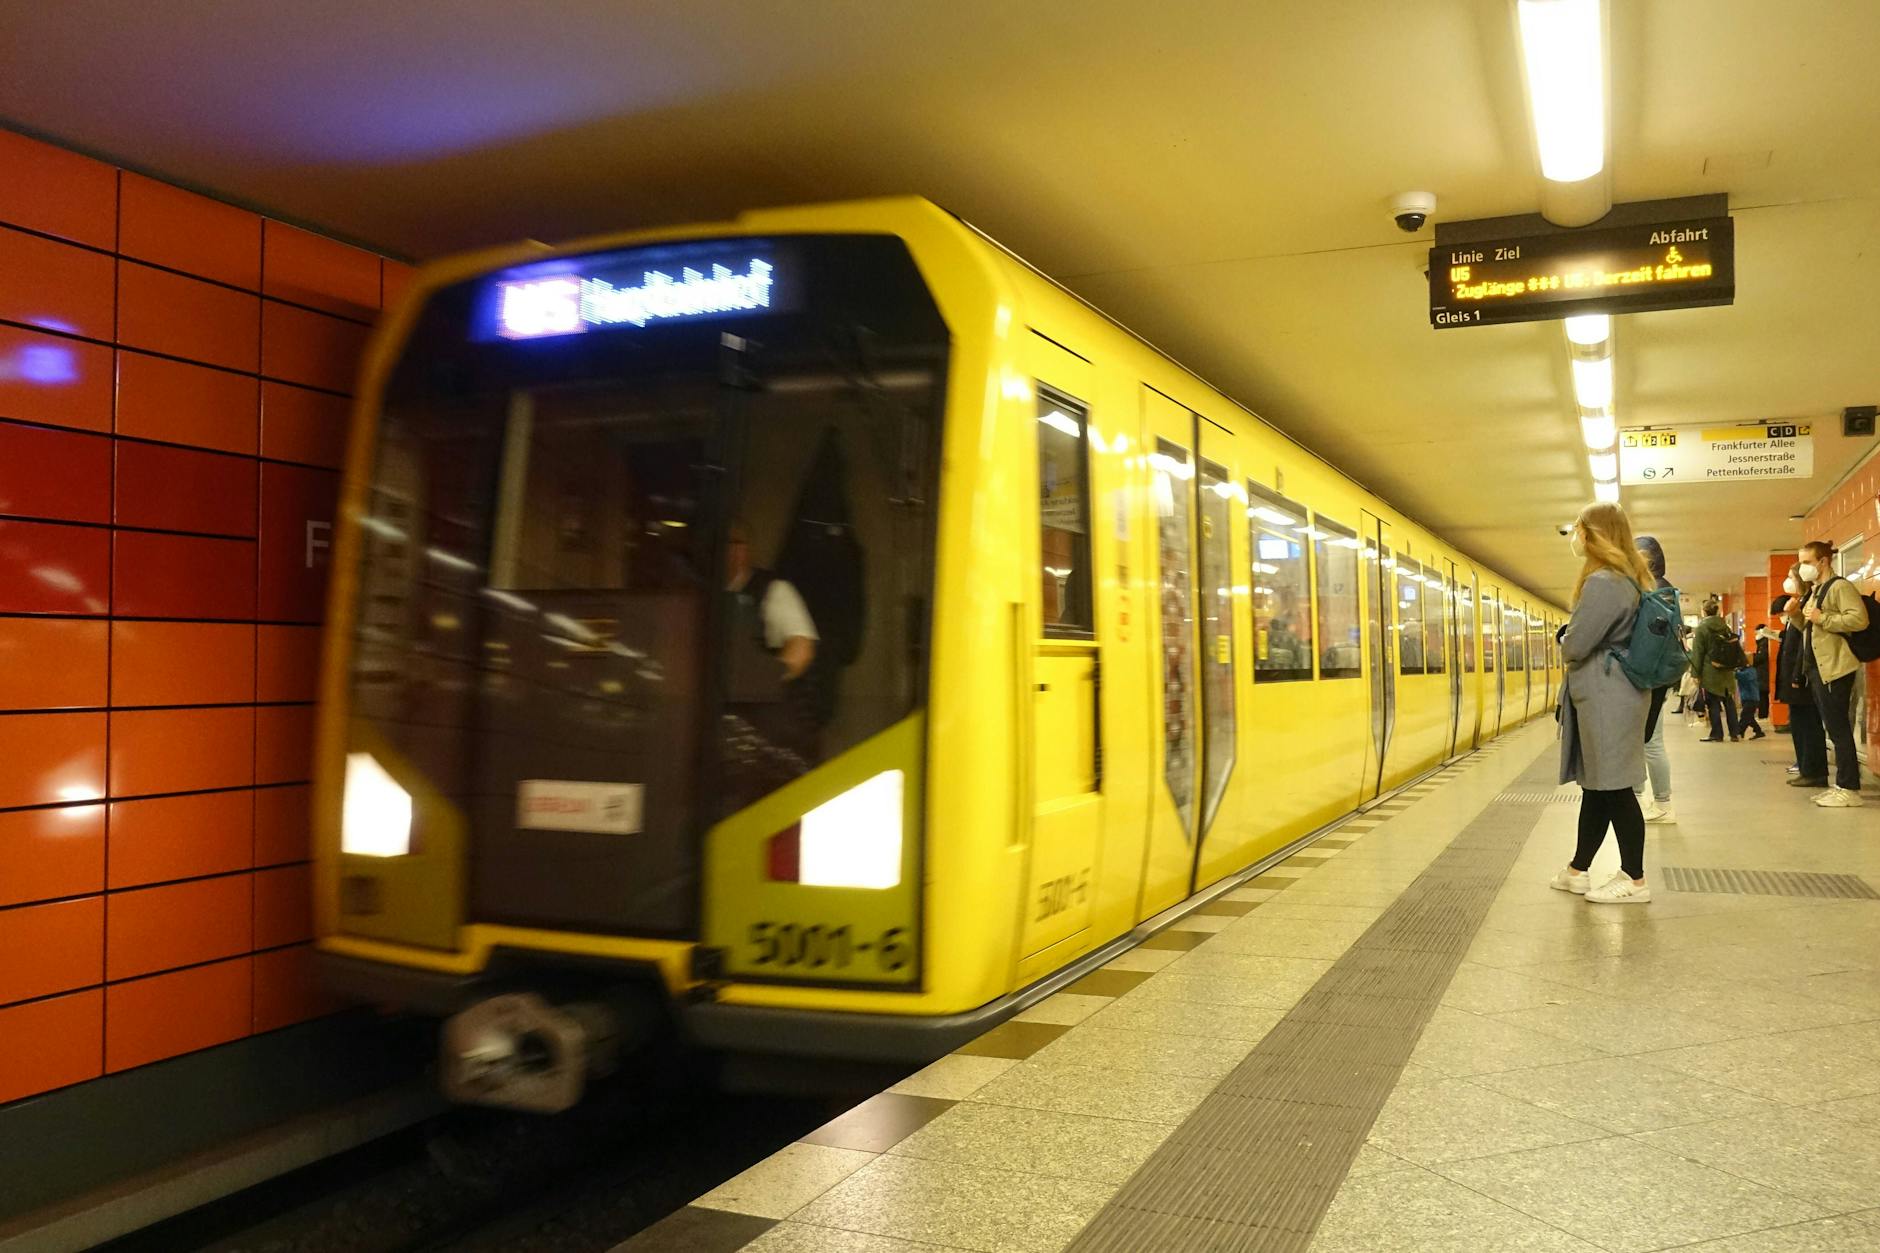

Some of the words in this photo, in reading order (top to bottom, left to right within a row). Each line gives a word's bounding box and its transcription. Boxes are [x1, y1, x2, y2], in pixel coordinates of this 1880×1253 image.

[1650, 228, 1709, 245] Abfahrt
[1451, 250, 1484, 265] Linie
[1495, 246, 1520, 261] Ziel
[1450, 266, 1470, 282] U5
[1456, 281, 1525, 299] Zuglänge
[1656, 264, 1712, 281] fahren
[1436, 311, 1470, 324] Gleis
[1474, 310, 1480, 320] 1
[1770, 428, 1778, 437] C
[1785, 427, 1793, 435] D
[1711, 441, 1767, 451] Frankfurter
[1770, 438, 1795, 448] Allee
[1728, 453, 1796, 463] Jessnerstraße
[1706, 466, 1795, 478] Pettenkoferstraße
